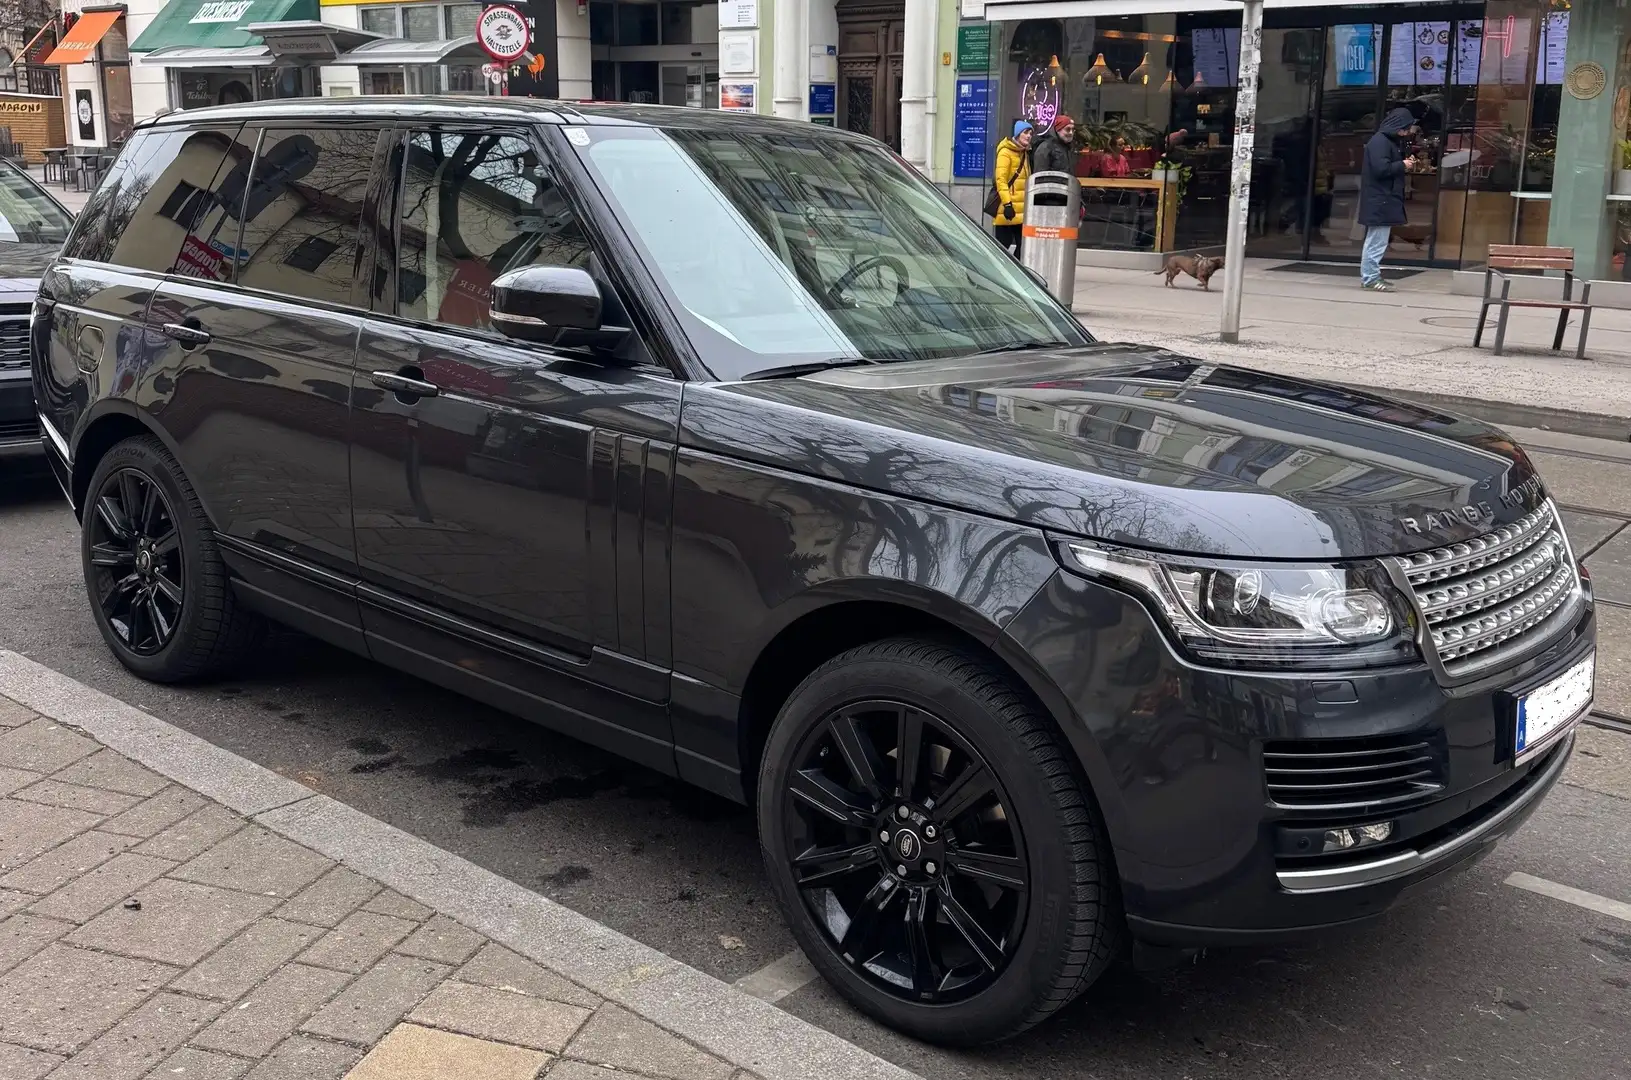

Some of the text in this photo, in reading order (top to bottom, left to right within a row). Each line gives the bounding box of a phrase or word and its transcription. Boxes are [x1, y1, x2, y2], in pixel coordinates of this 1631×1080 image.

[484, 11, 524, 32] STRASSENBAHN
[485, 35, 522, 53] HALTESTELLE
[1400, 501, 1494, 535] RANGE
